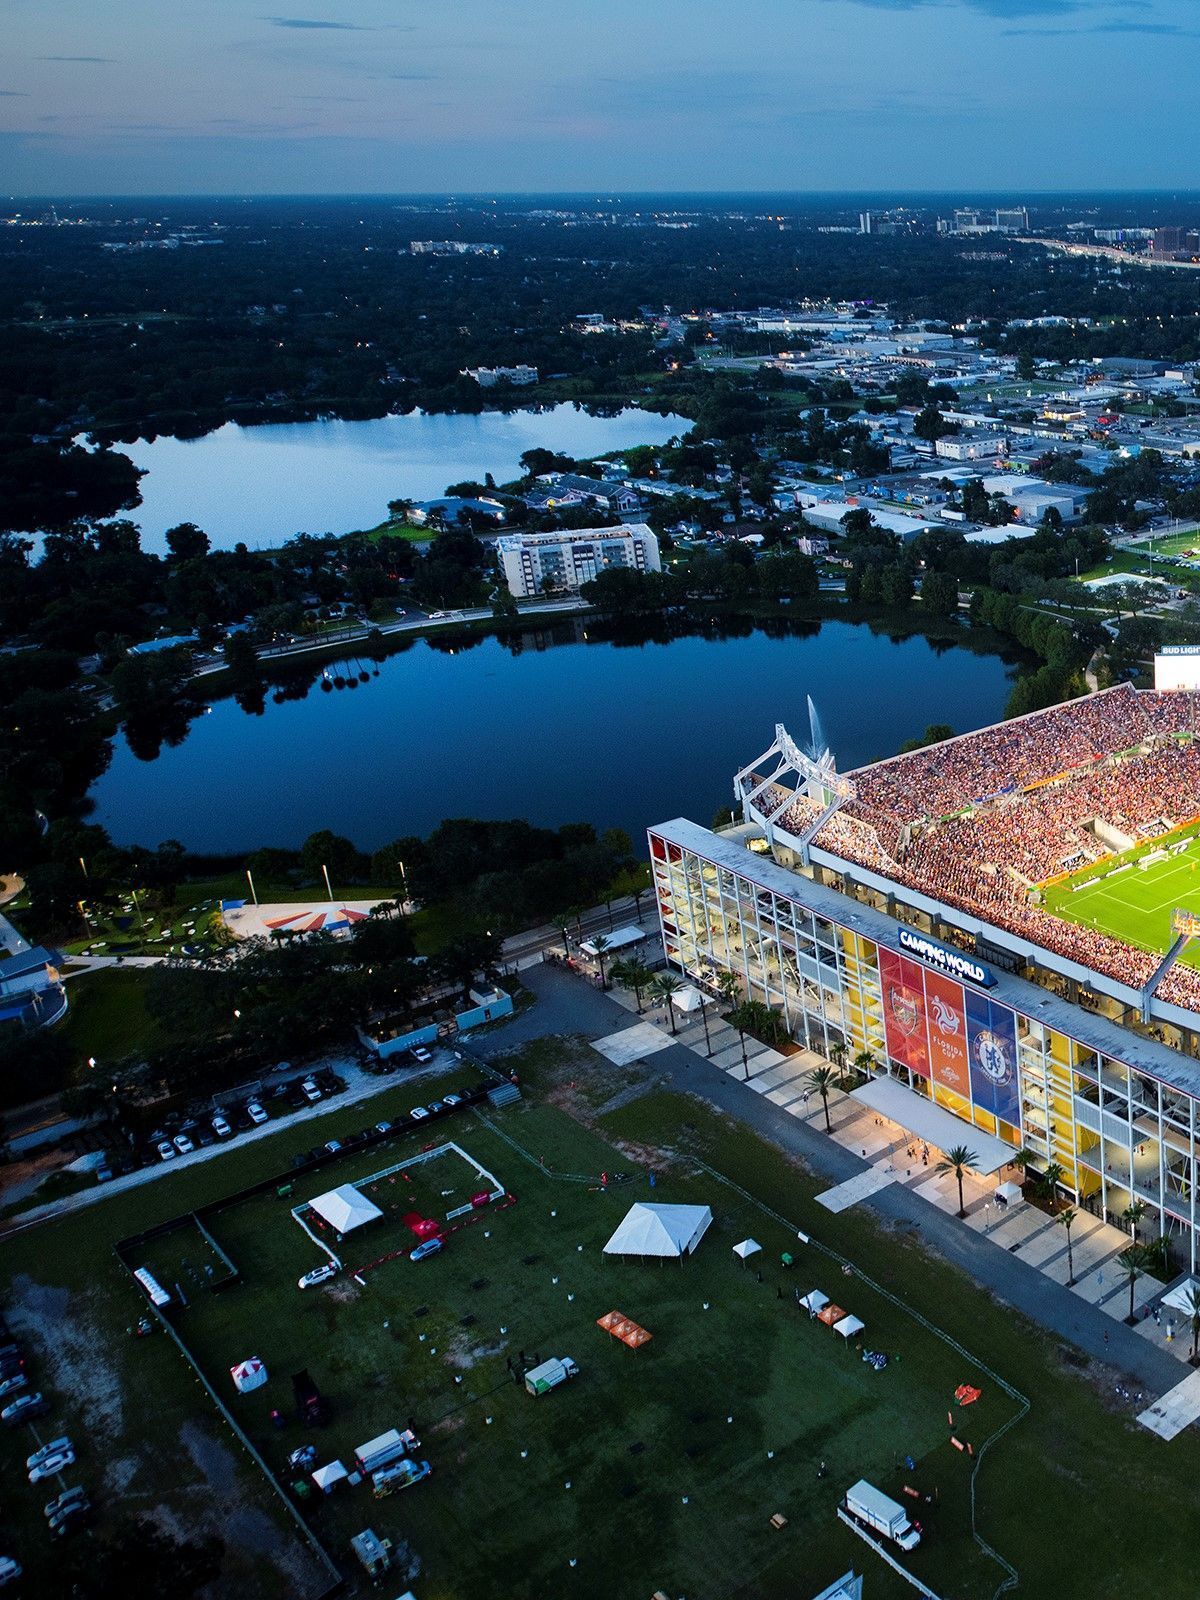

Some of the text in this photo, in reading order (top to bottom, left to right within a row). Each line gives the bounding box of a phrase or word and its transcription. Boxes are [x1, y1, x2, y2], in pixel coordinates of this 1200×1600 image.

[900, 931, 985, 981] CAMPING WORLD
[932, 1035, 964, 1058] FLORIDA
[942, 1048, 956, 1060] CUP
